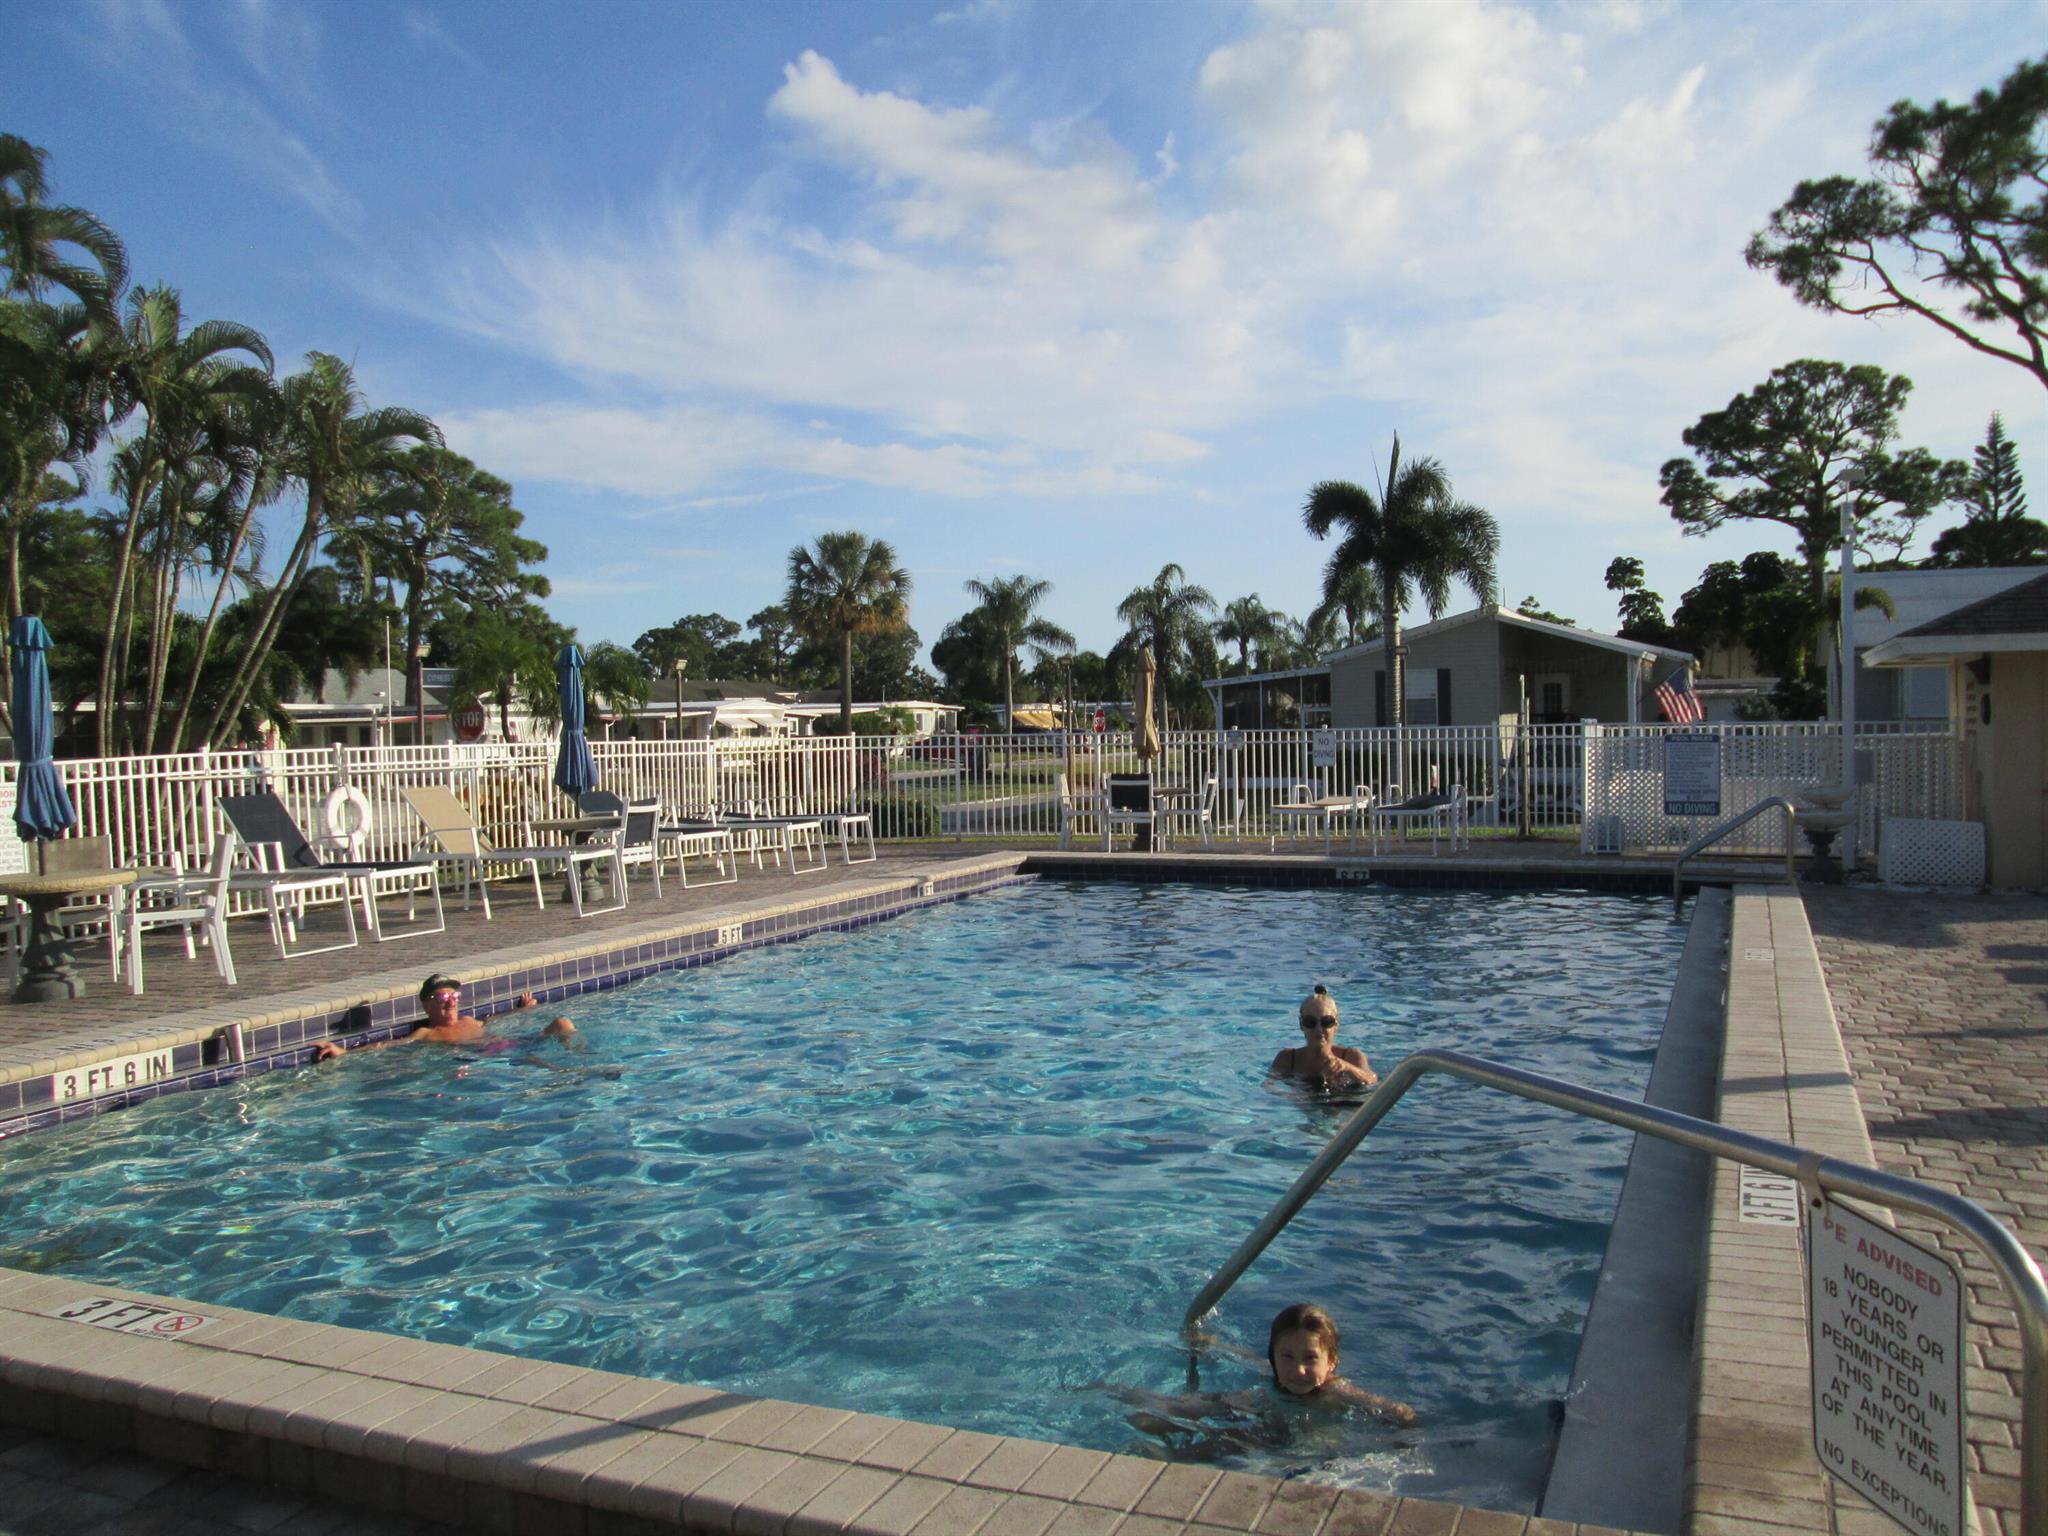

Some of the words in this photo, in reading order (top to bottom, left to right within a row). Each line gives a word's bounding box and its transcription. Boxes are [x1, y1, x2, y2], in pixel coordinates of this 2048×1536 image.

[1318, 737, 1330, 746] NO
[1669, 803, 1681, 813] NO
[1684, 803, 1716, 814] DIVING
[722, 929, 728, 945] 5
[731, 926, 741, 944] FT
[64, 1075, 77, 1098] 3
[124, 1061, 136, 1084] 6
[1843, 1263, 1918, 1320] NOBODY
[1857, 1237, 1942, 1296] ADVISED
[60, 1300, 113, 1318] 3
[89, 1304, 171, 1329] FT
[1824, 1276, 1838, 1298] 18
[1847, 1289, 1907, 1341] YEARS
[1917, 1333, 1944, 1364] OR
[1841, 1309, 1924, 1377] YOUNGER
[1822, 1321, 1919, 1398] PERMITTED
[1929, 1390, 1946, 1417] IN
[1836, 1353, 1873, 1393] THIS
[1881, 1384, 1932, 1432] POOL
[1822, 1392, 1844, 1416] OF
[1852, 1411, 1886, 1449] THE
[1896, 1441, 1951, 1496] YEAR.
[1831, 1375, 1850, 1400] AT
[1860, 1396, 1939, 1462] ANYTIME
[1823, 1438, 1845, 1465] NO
[1851, 1457, 1950, 1536] EXCEPTIONS
